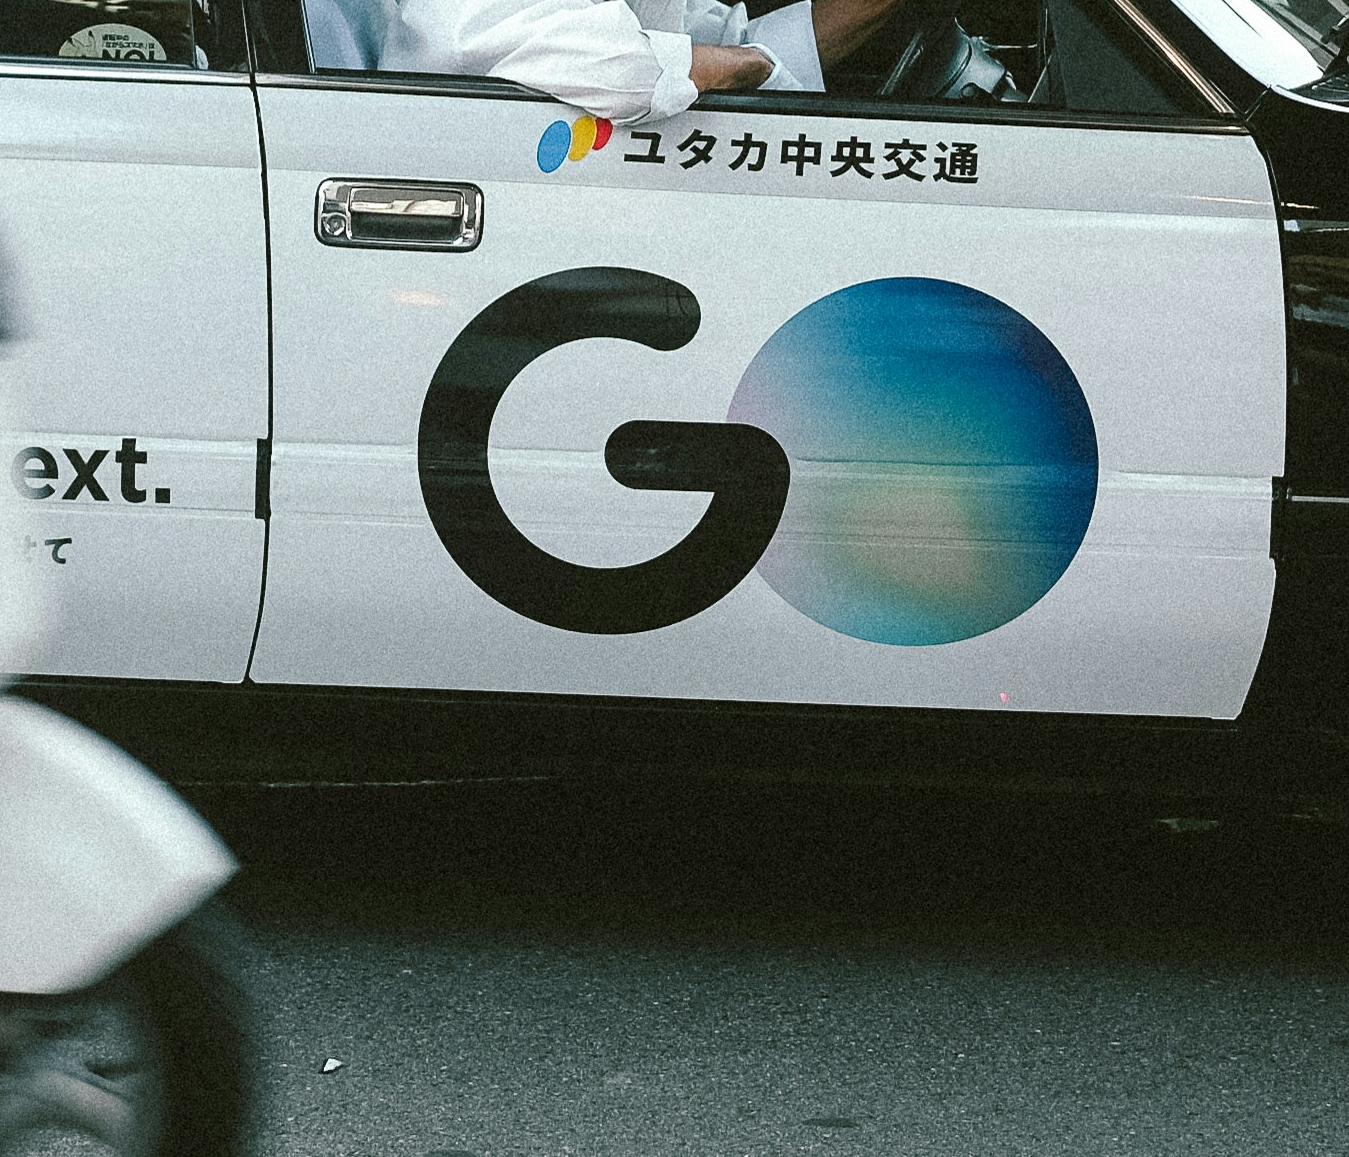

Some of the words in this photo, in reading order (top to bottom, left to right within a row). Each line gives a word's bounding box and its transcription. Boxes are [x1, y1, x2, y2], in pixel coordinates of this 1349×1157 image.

[623, 129, 980, 184] ユタカ中央交通
[417, 266, 1099, 646] GO
